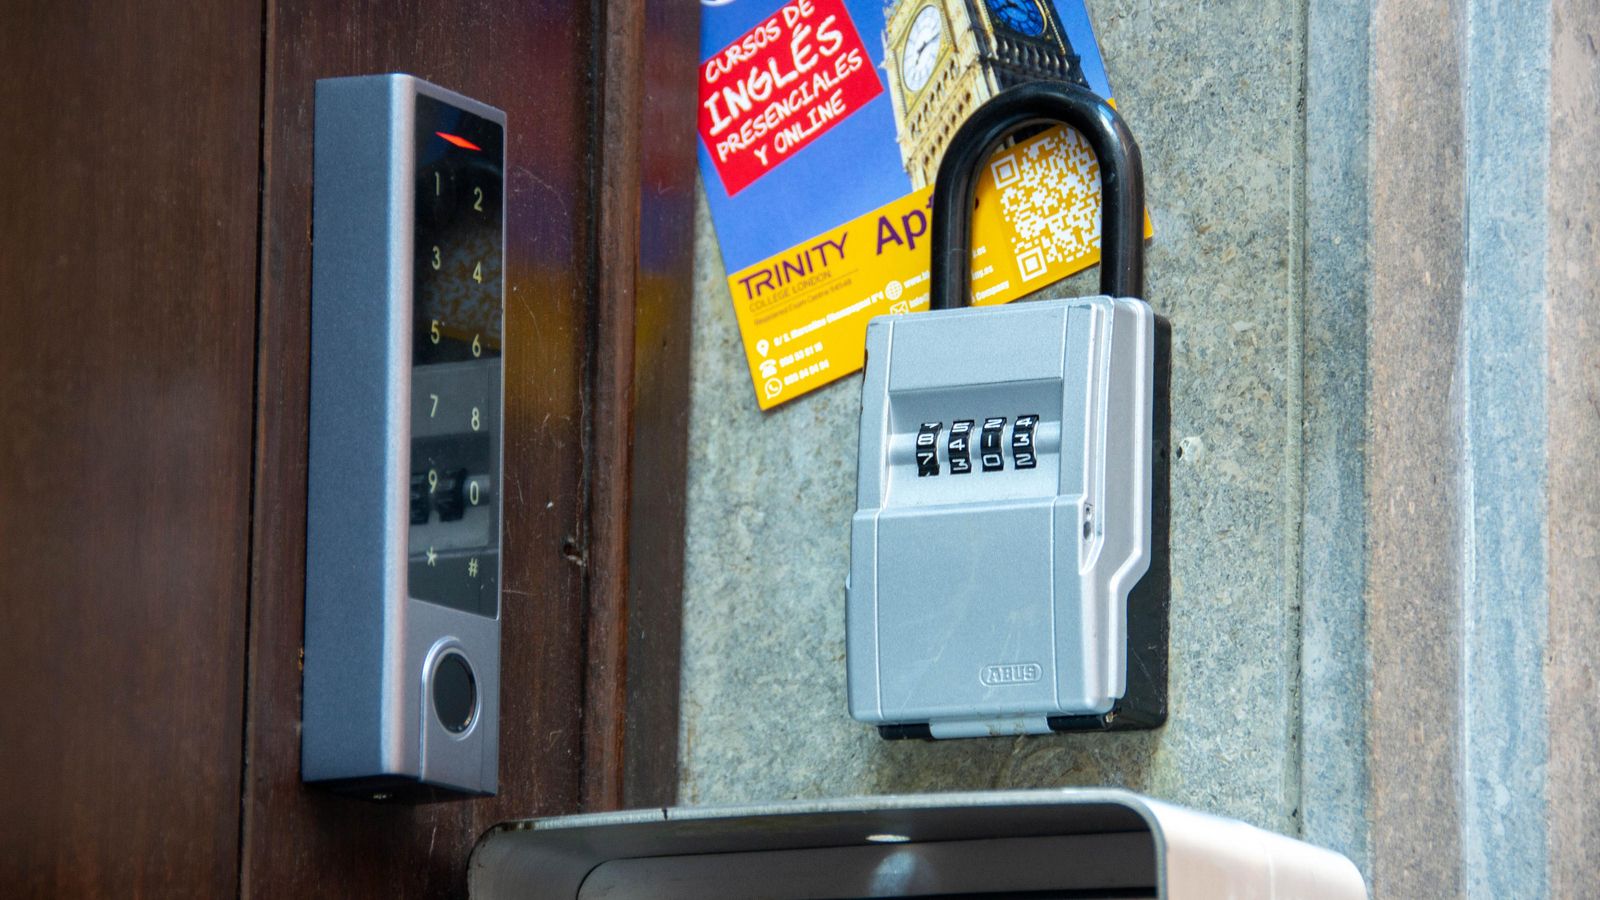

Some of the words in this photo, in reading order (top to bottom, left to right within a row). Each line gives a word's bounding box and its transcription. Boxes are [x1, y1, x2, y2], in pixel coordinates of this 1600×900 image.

[705, 18, 781, 83] CURSOS
[783, 0, 815, 29] DE
[704, 15, 843, 136] INGLÉS
[716, 48, 863, 162] PRESENCIALES
[754, 145, 768, 166] Y
[774, 89, 846, 154] ONLINE
[434, 171, 440, 196] 1
[473, 187, 482, 212] 2
[432, 246, 441, 270] 3
[472, 261, 482, 284] 4
[738, 231, 848, 300] TRINITY
[430, 320, 440, 344] 5
[472, 334, 481, 357] 6
[430, 394, 438, 418] 7
[471, 407, 480, 431] 8
[428, 469, 437, 494] 9
[469, 480, 479, 505] 0
[986, 665, 1035, 682] ABUS
